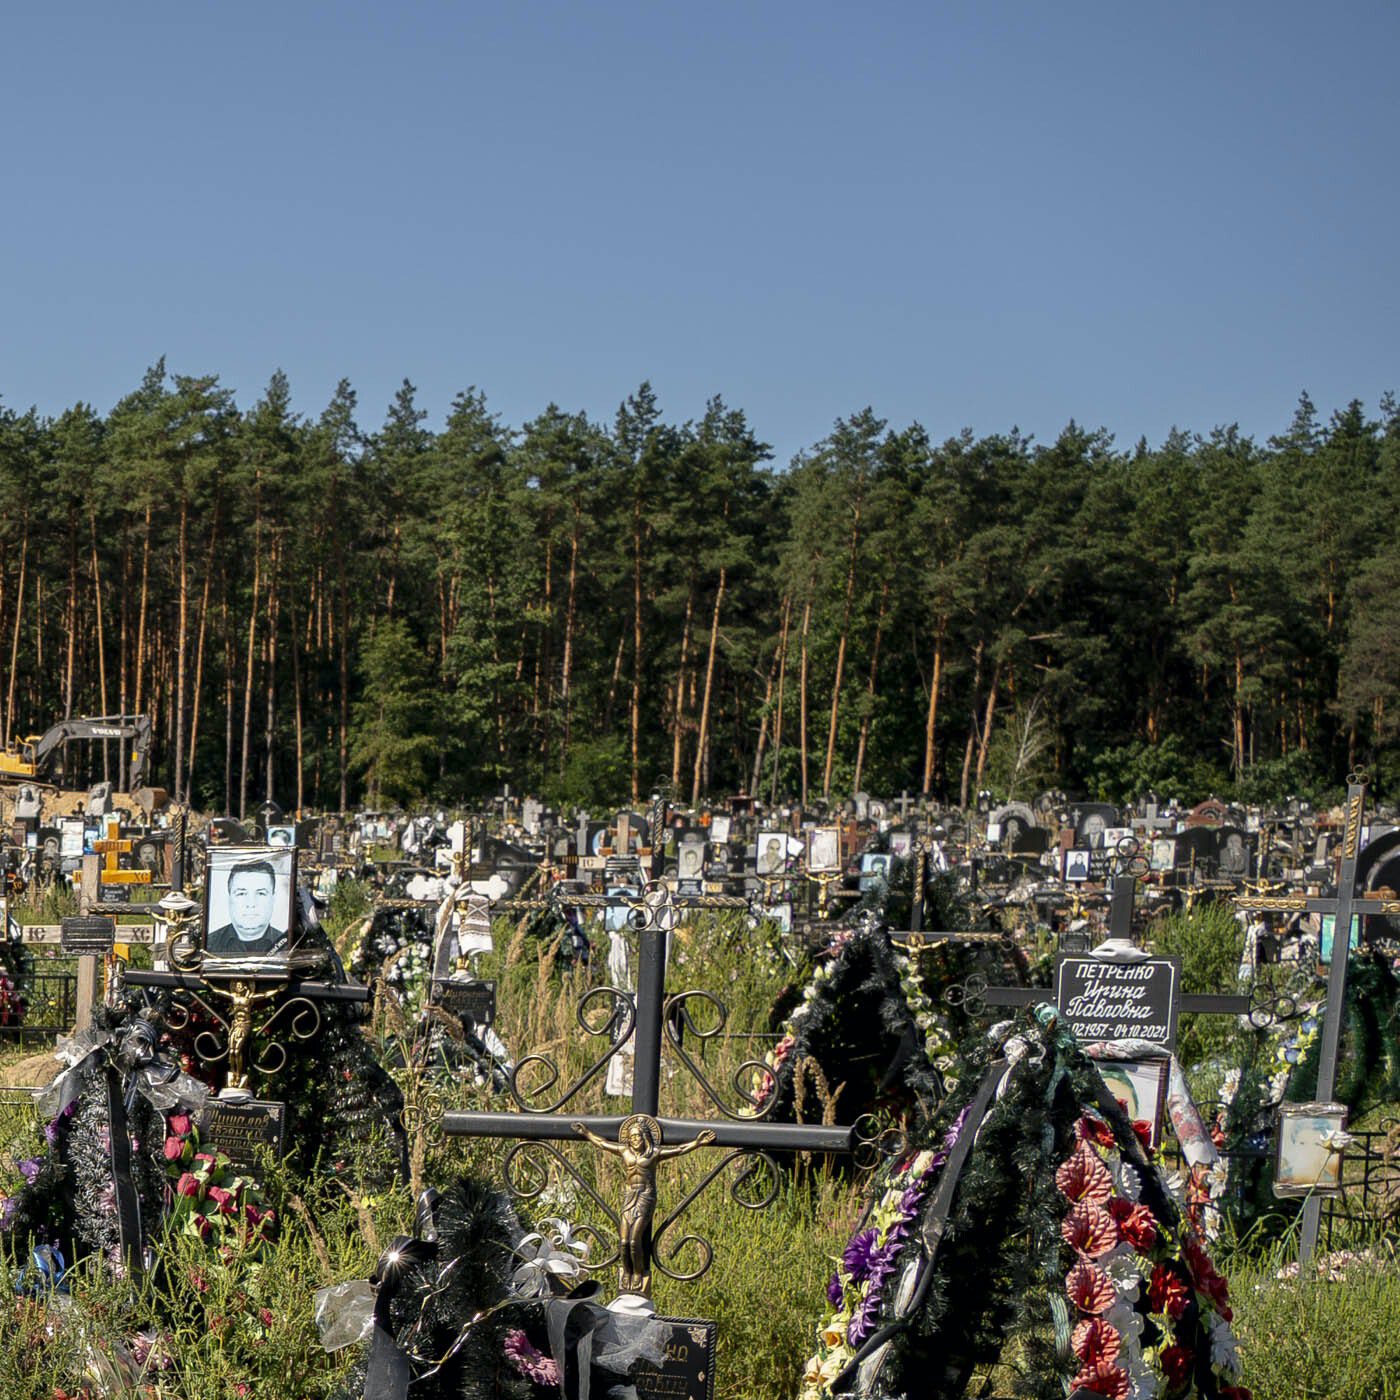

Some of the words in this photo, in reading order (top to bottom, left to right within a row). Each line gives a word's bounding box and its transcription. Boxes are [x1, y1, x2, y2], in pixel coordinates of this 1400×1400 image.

[91, 727, 121, 736] VOLVO
[1075, 964, 1155, 980] ПЕТРЕНКО
[1083, 980, 1147, 1001] Ирина
[1066, 995, 1154, 1020] Павловна
